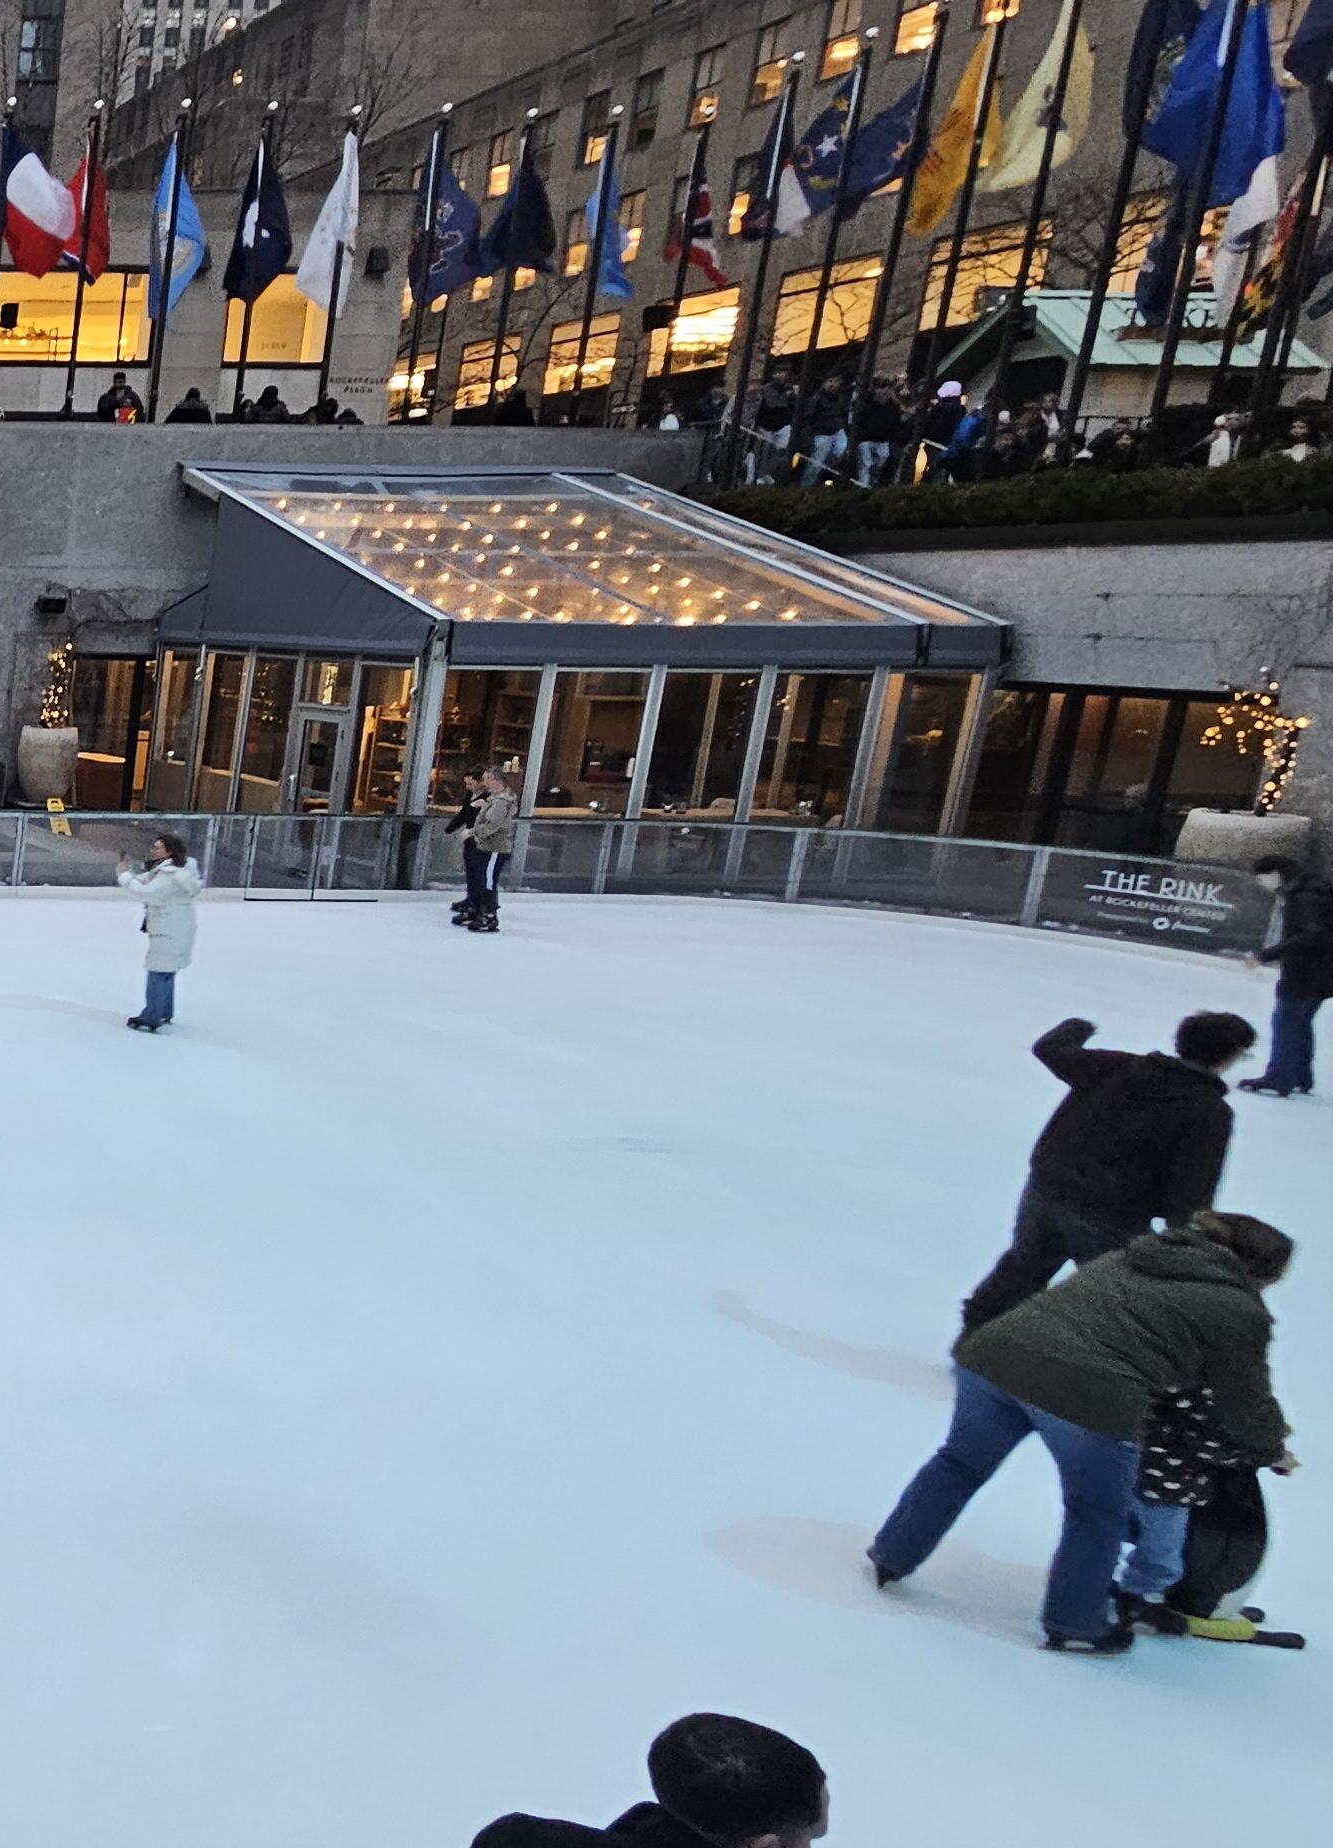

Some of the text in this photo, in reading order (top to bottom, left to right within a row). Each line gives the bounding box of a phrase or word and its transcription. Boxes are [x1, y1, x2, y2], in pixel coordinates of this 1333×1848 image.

[1101, 869, 1224, 903] THE RINK
[1088, 895, 1103, 903] AT
[1105, 896, 1180, 913] ROCKEFELLER
